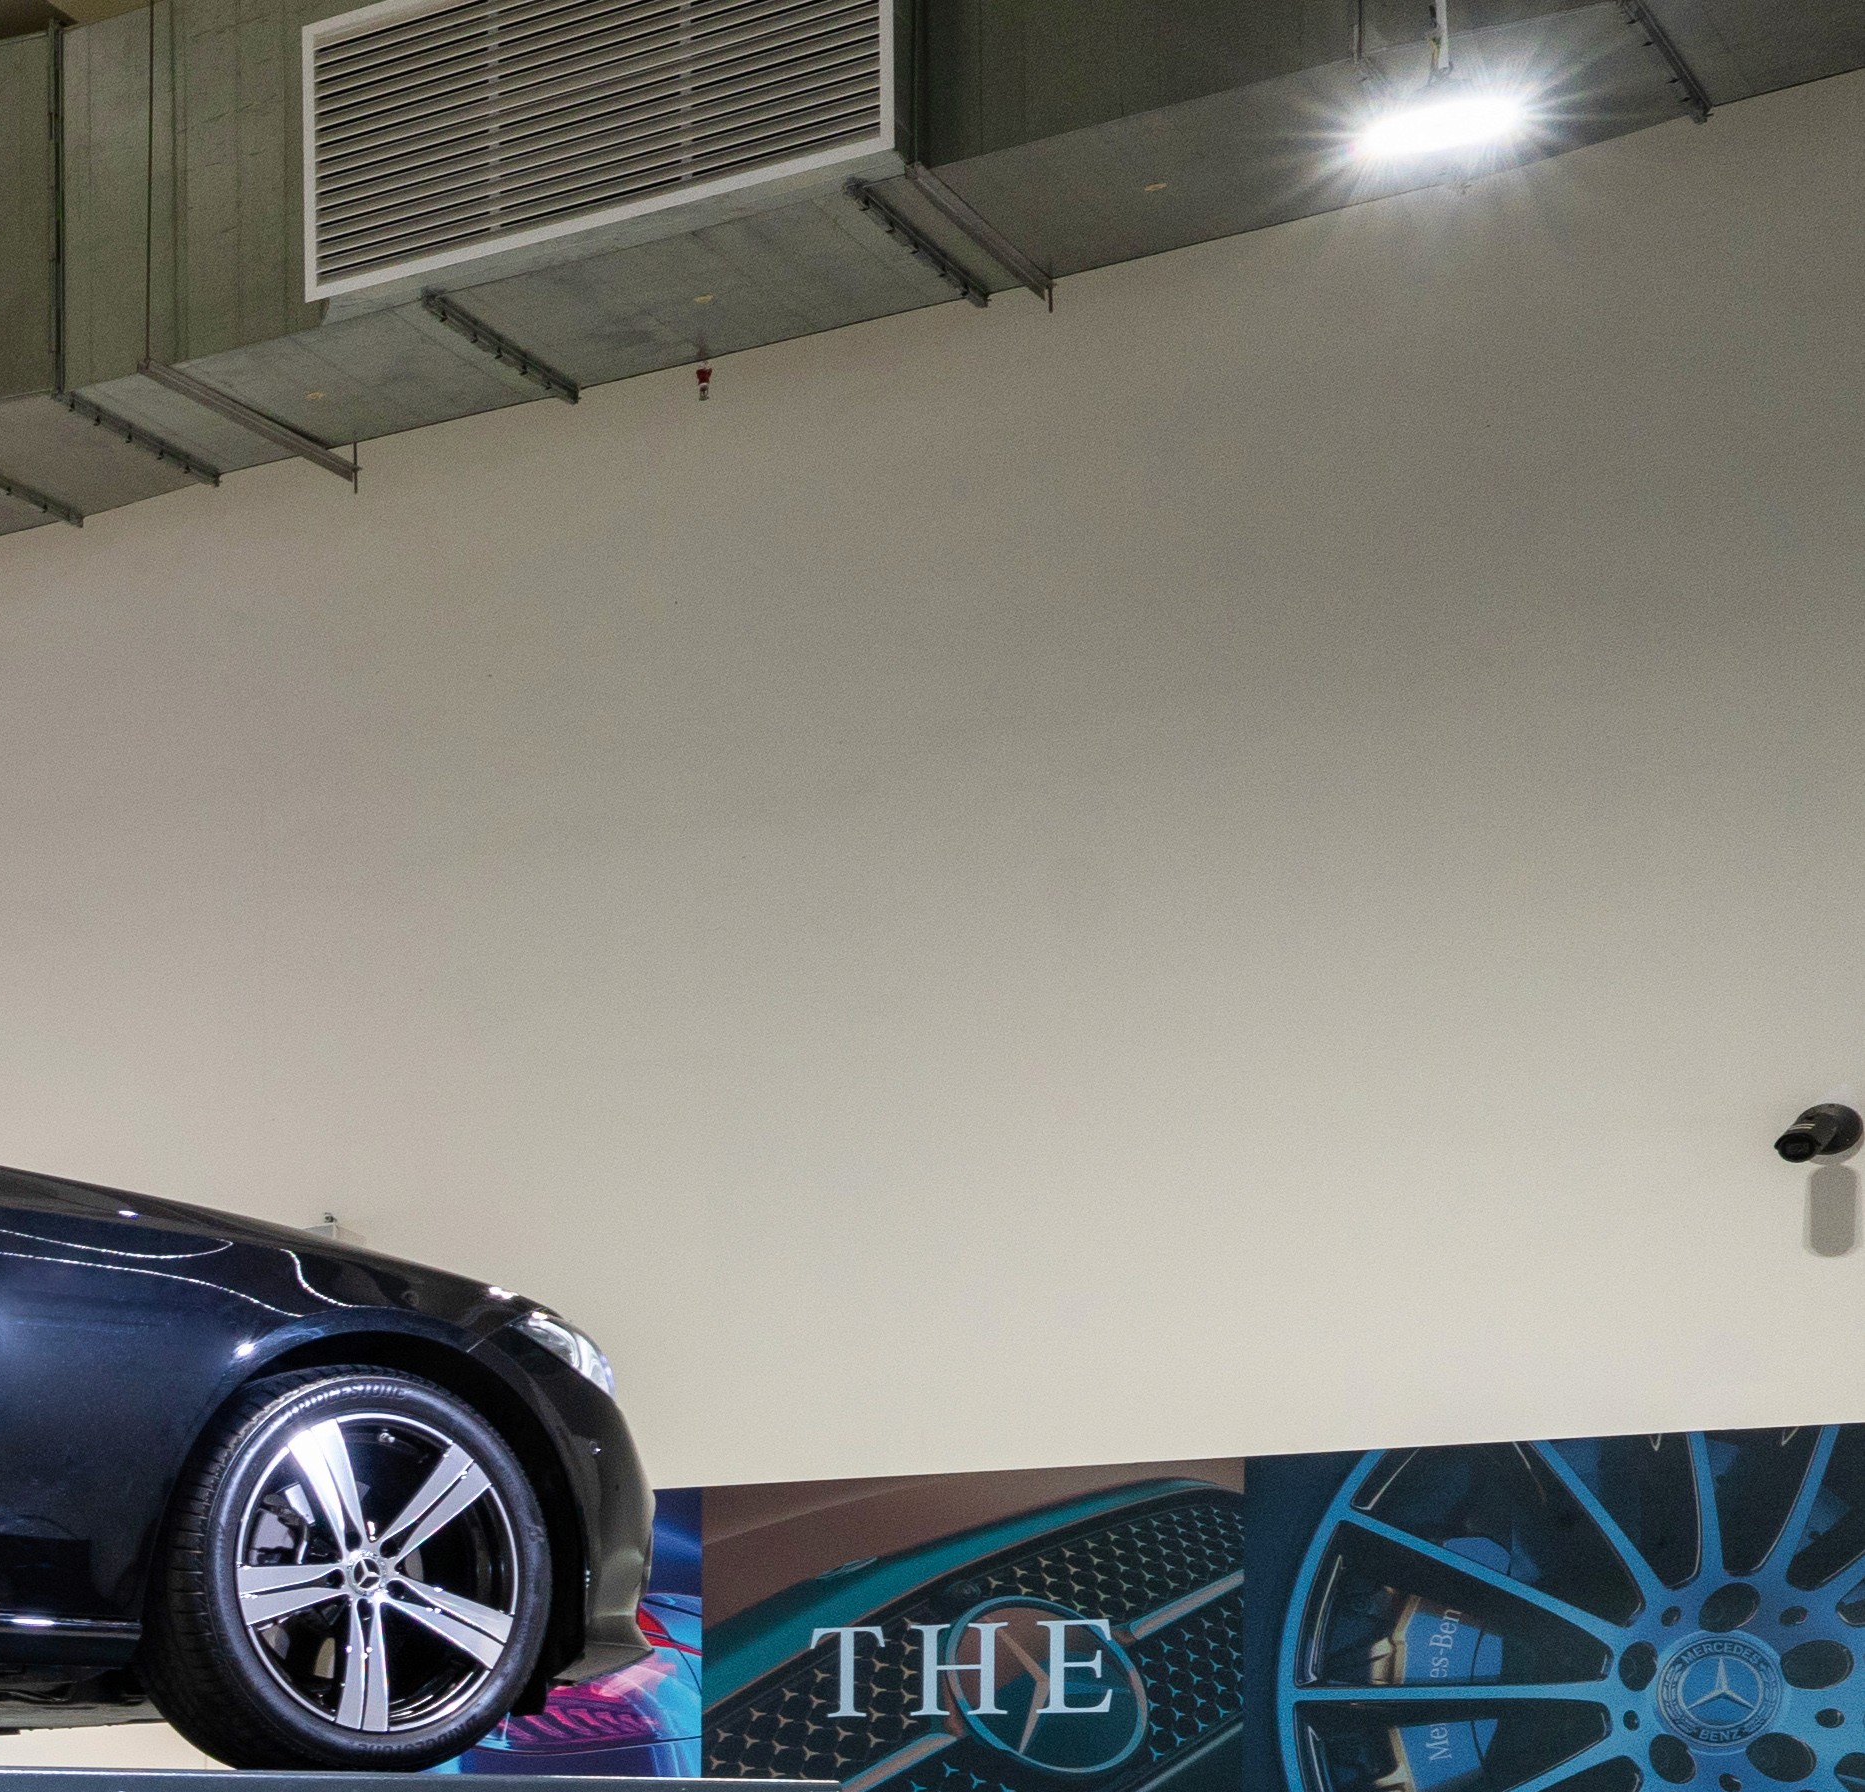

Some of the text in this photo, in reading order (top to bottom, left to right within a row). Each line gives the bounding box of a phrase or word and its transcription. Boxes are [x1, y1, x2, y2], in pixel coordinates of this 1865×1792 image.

[1681, 1642, 1762, 1665] MERCEDES
[810, 1619, 1112, 1718] THE
[1698, 1728, 1743, 1742] BENZ
